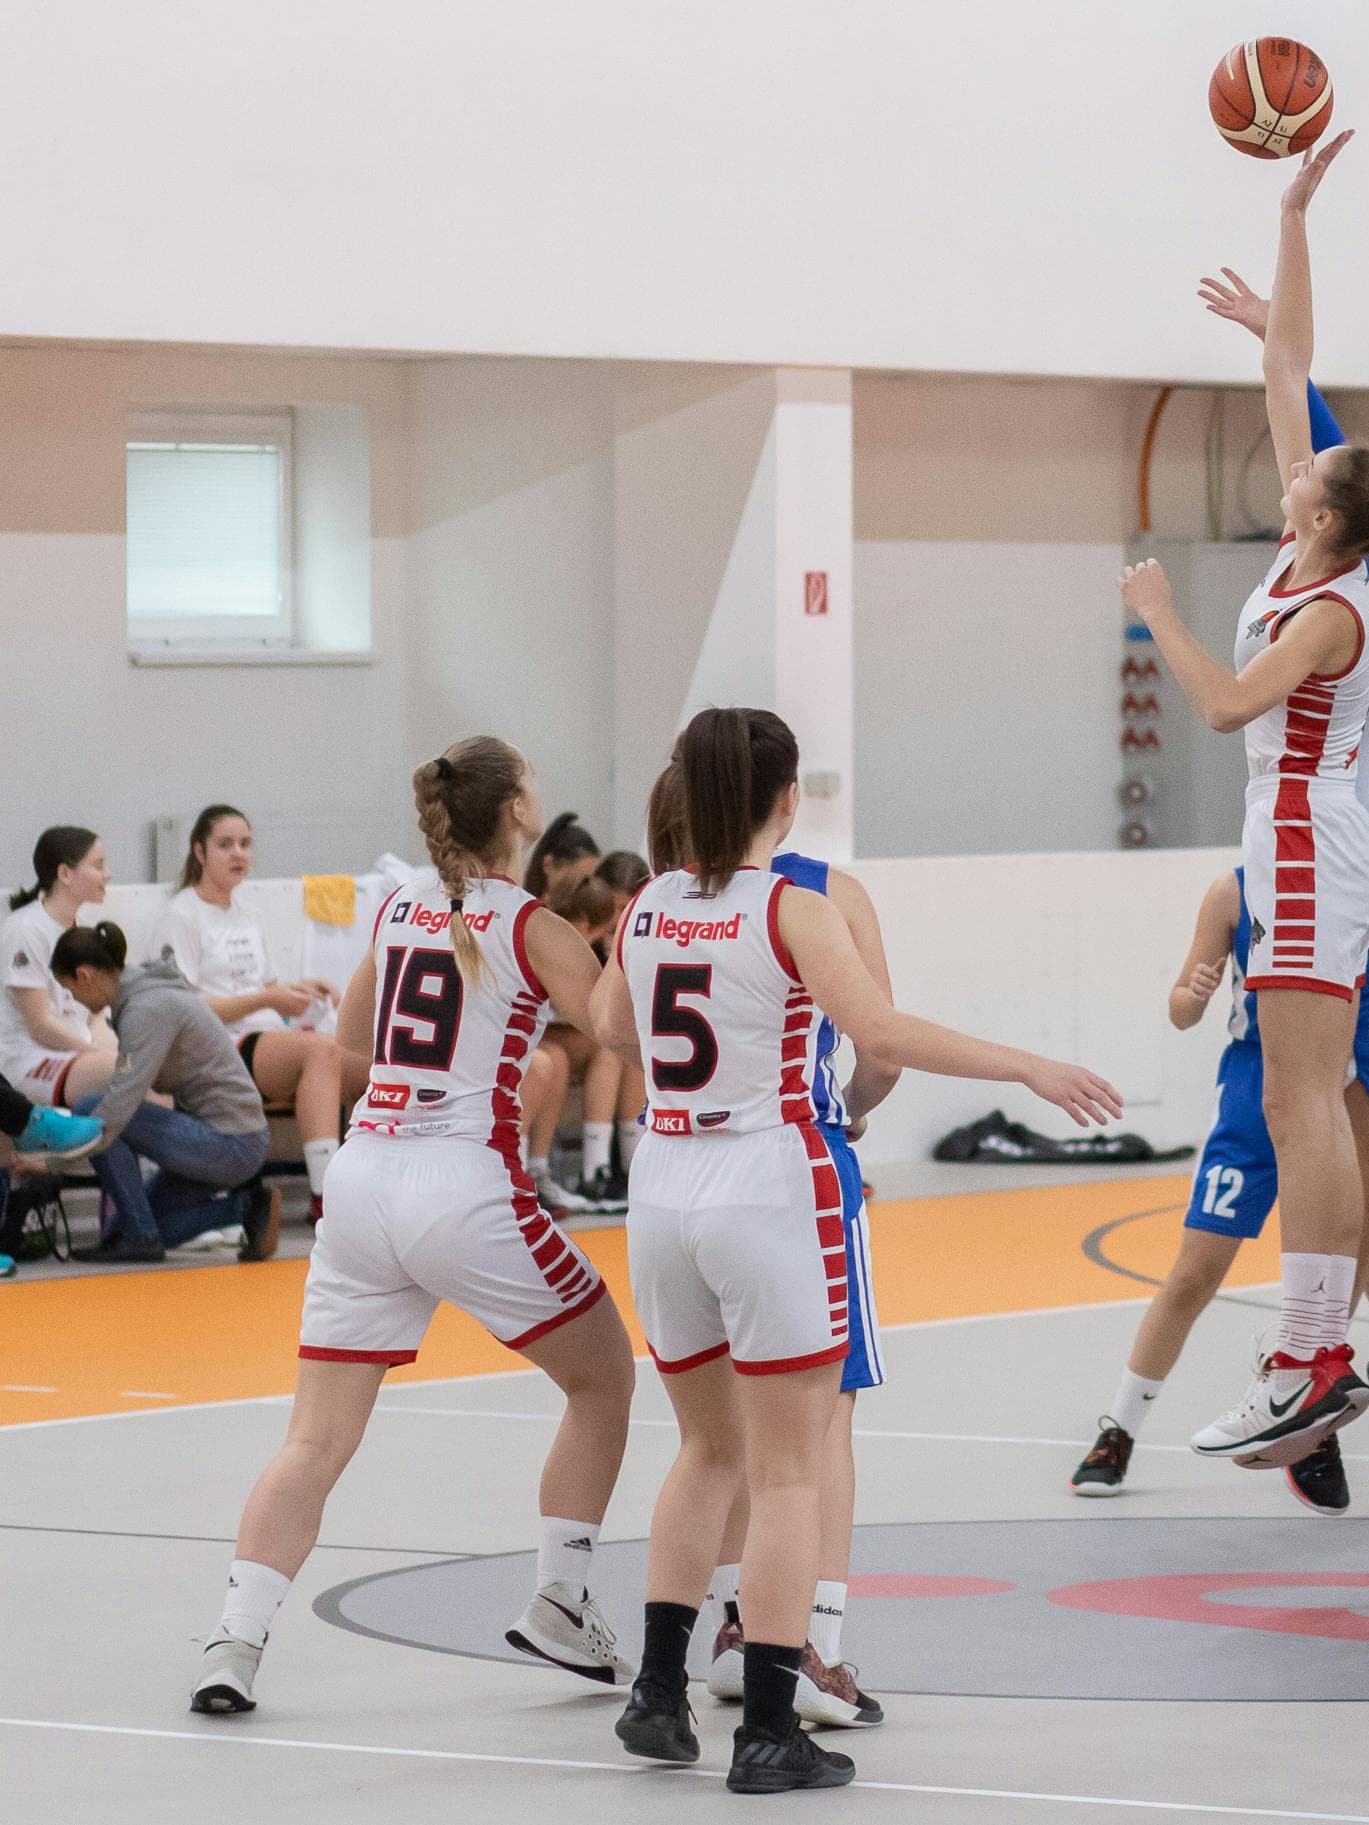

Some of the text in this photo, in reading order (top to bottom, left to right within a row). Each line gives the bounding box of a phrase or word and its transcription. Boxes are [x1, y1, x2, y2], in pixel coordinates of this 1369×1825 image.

[408, 902, 495, 935] legrnd
[655, 911, 742, 948] legrand
[374, 945, 464, 1073] 19
[651, 962, 719, 1093] 5
[1202, 1164, 1244, 1219] 12
[812, 1604, 843, 1617] didas
